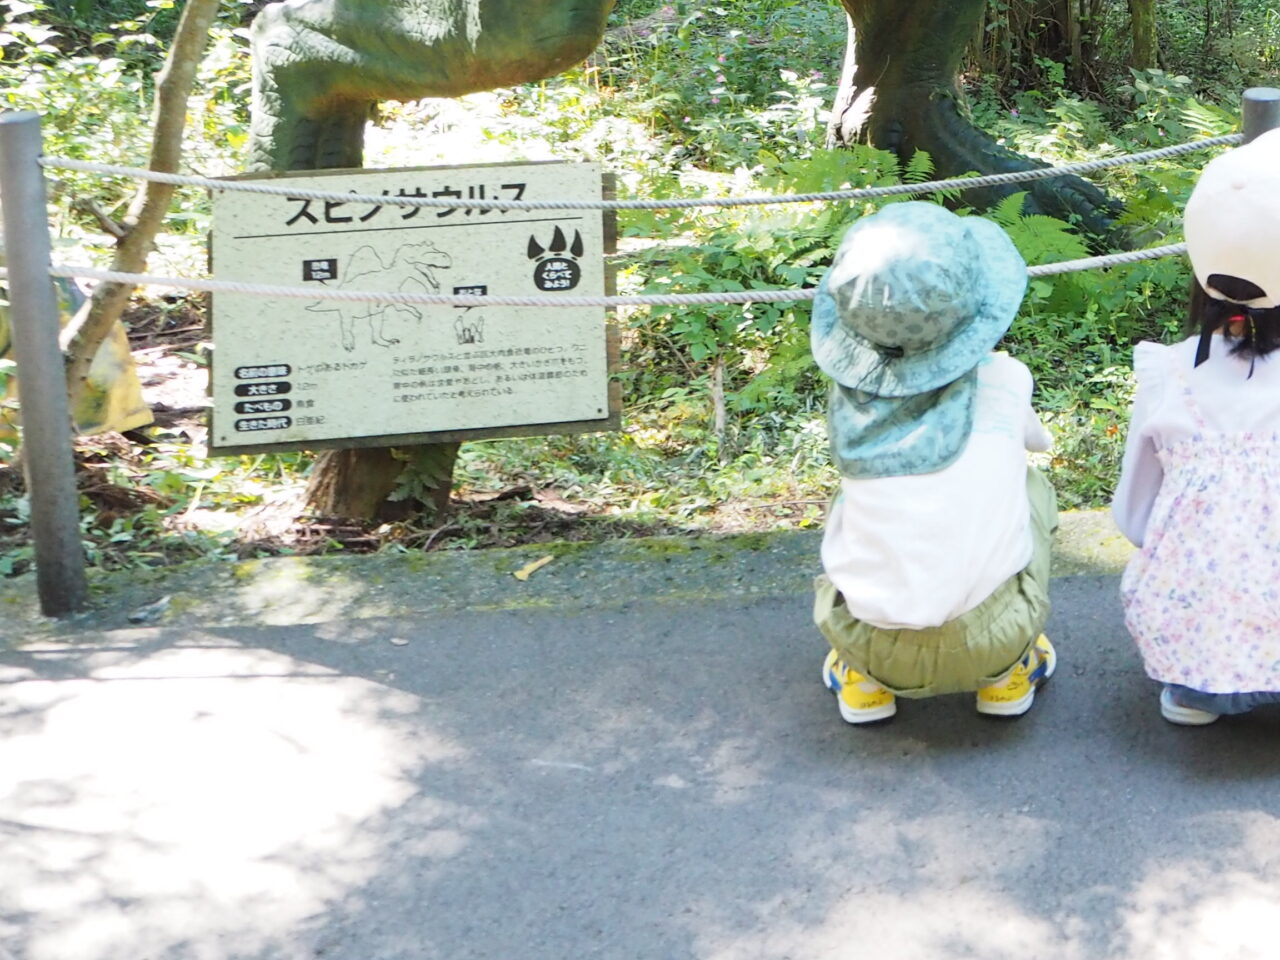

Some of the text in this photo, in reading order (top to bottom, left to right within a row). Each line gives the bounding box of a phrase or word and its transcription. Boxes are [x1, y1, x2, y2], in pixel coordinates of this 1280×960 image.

[285, 183, 531, 226] スピノサウルス
[542, 270, 573, 280] くらべて
[248, 384, 278, 395] 大きさ
[244, 401, 283, 413] たべもの
[238, 418, 288, 431] 生きた時代
